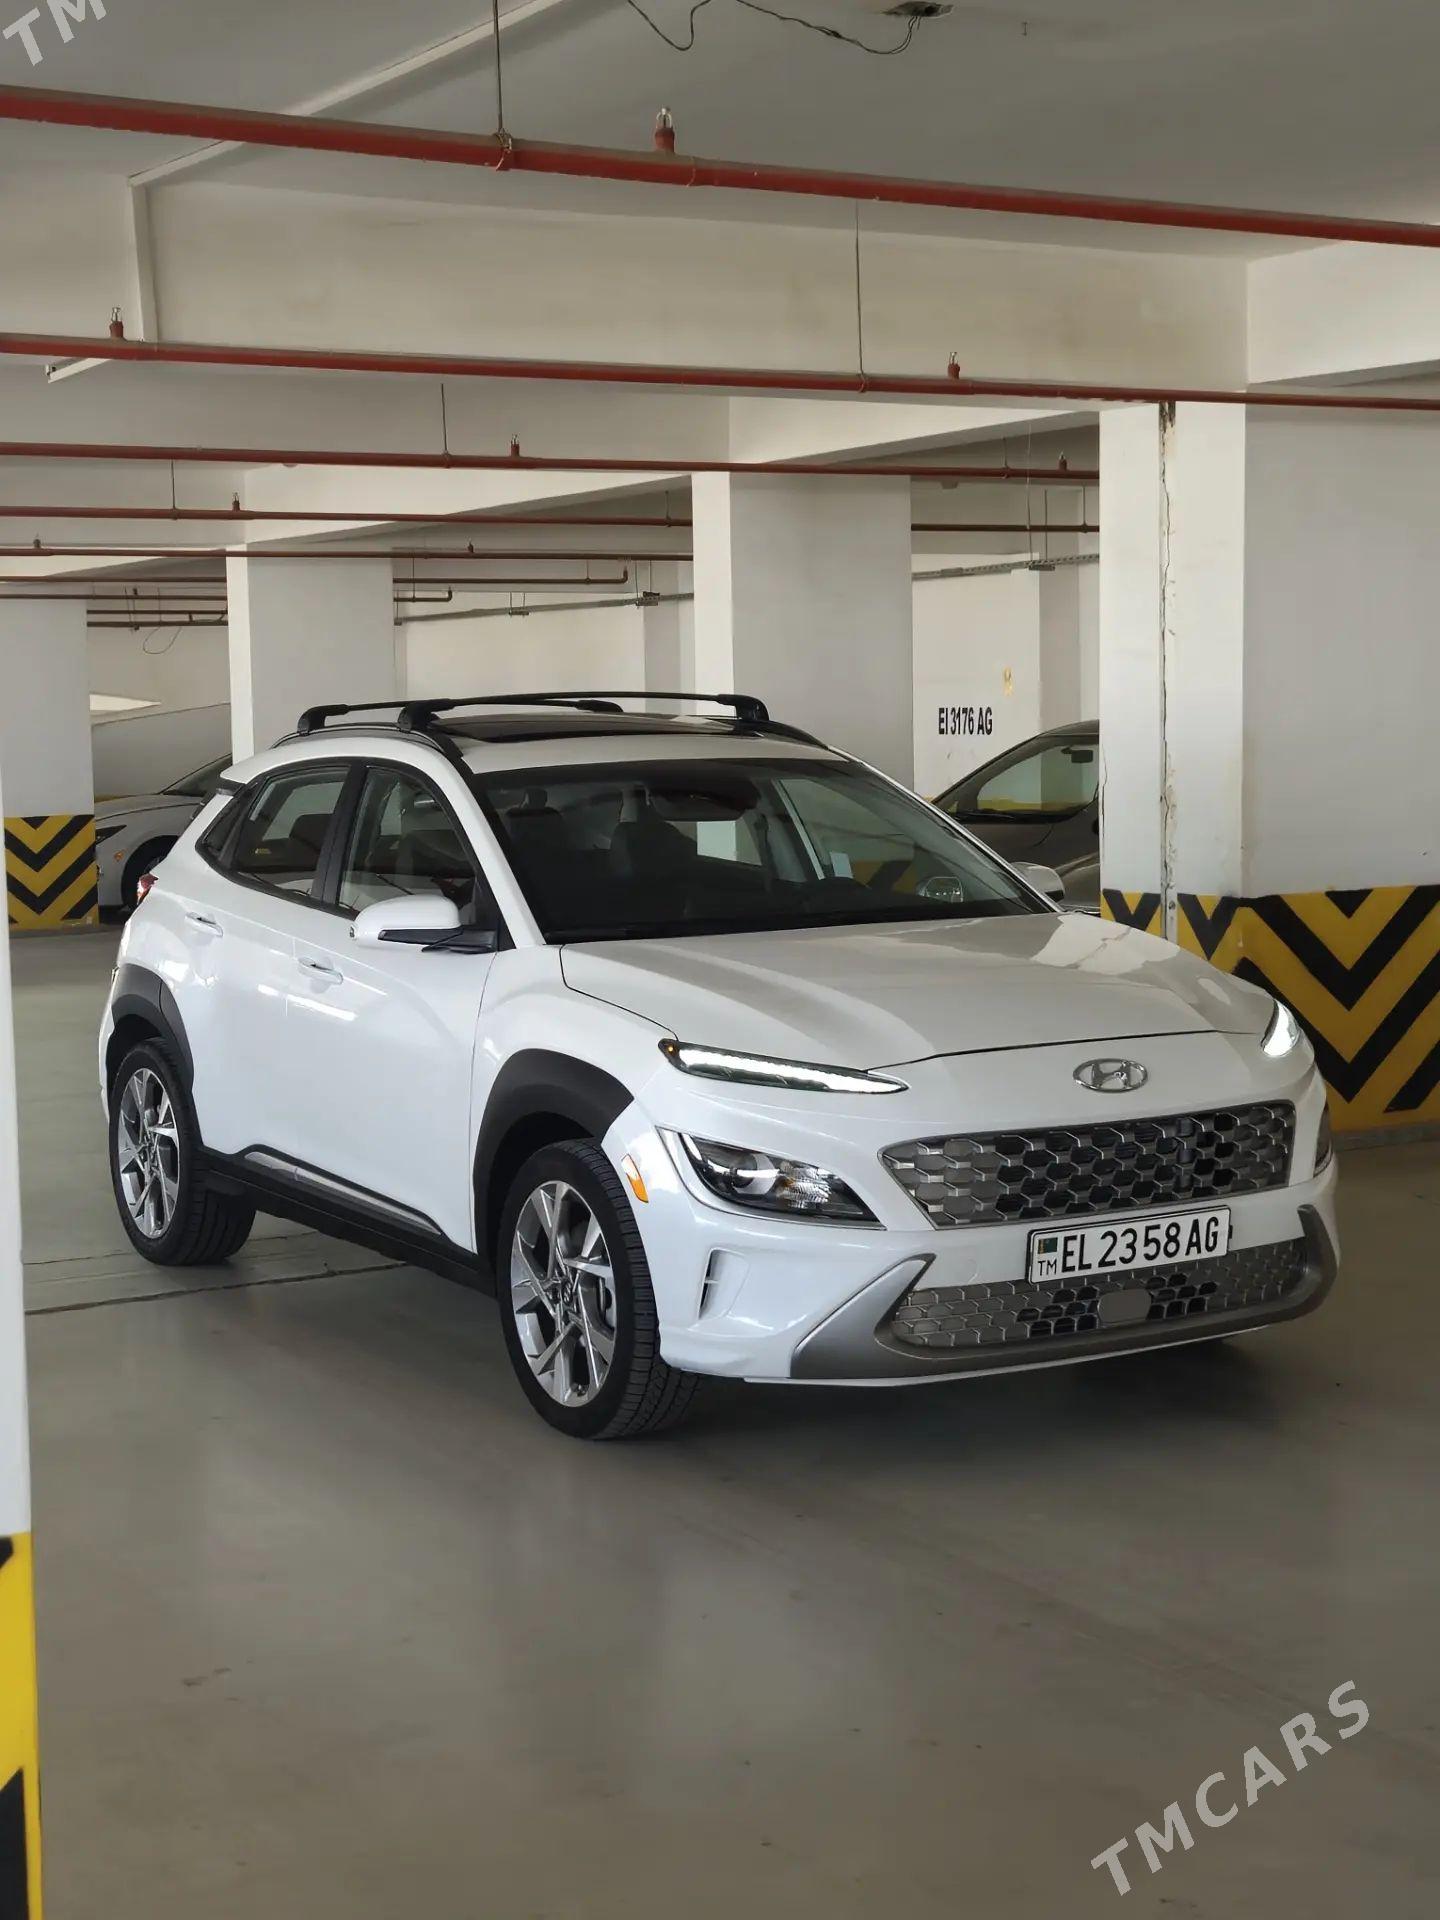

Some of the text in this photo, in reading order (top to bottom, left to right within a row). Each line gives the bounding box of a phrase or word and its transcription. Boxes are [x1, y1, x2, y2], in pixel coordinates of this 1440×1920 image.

[950, 706, 975, 735] 3176
[976, 706, 993, 735] AG
[1037, 1258, 1057, 1277] TM
